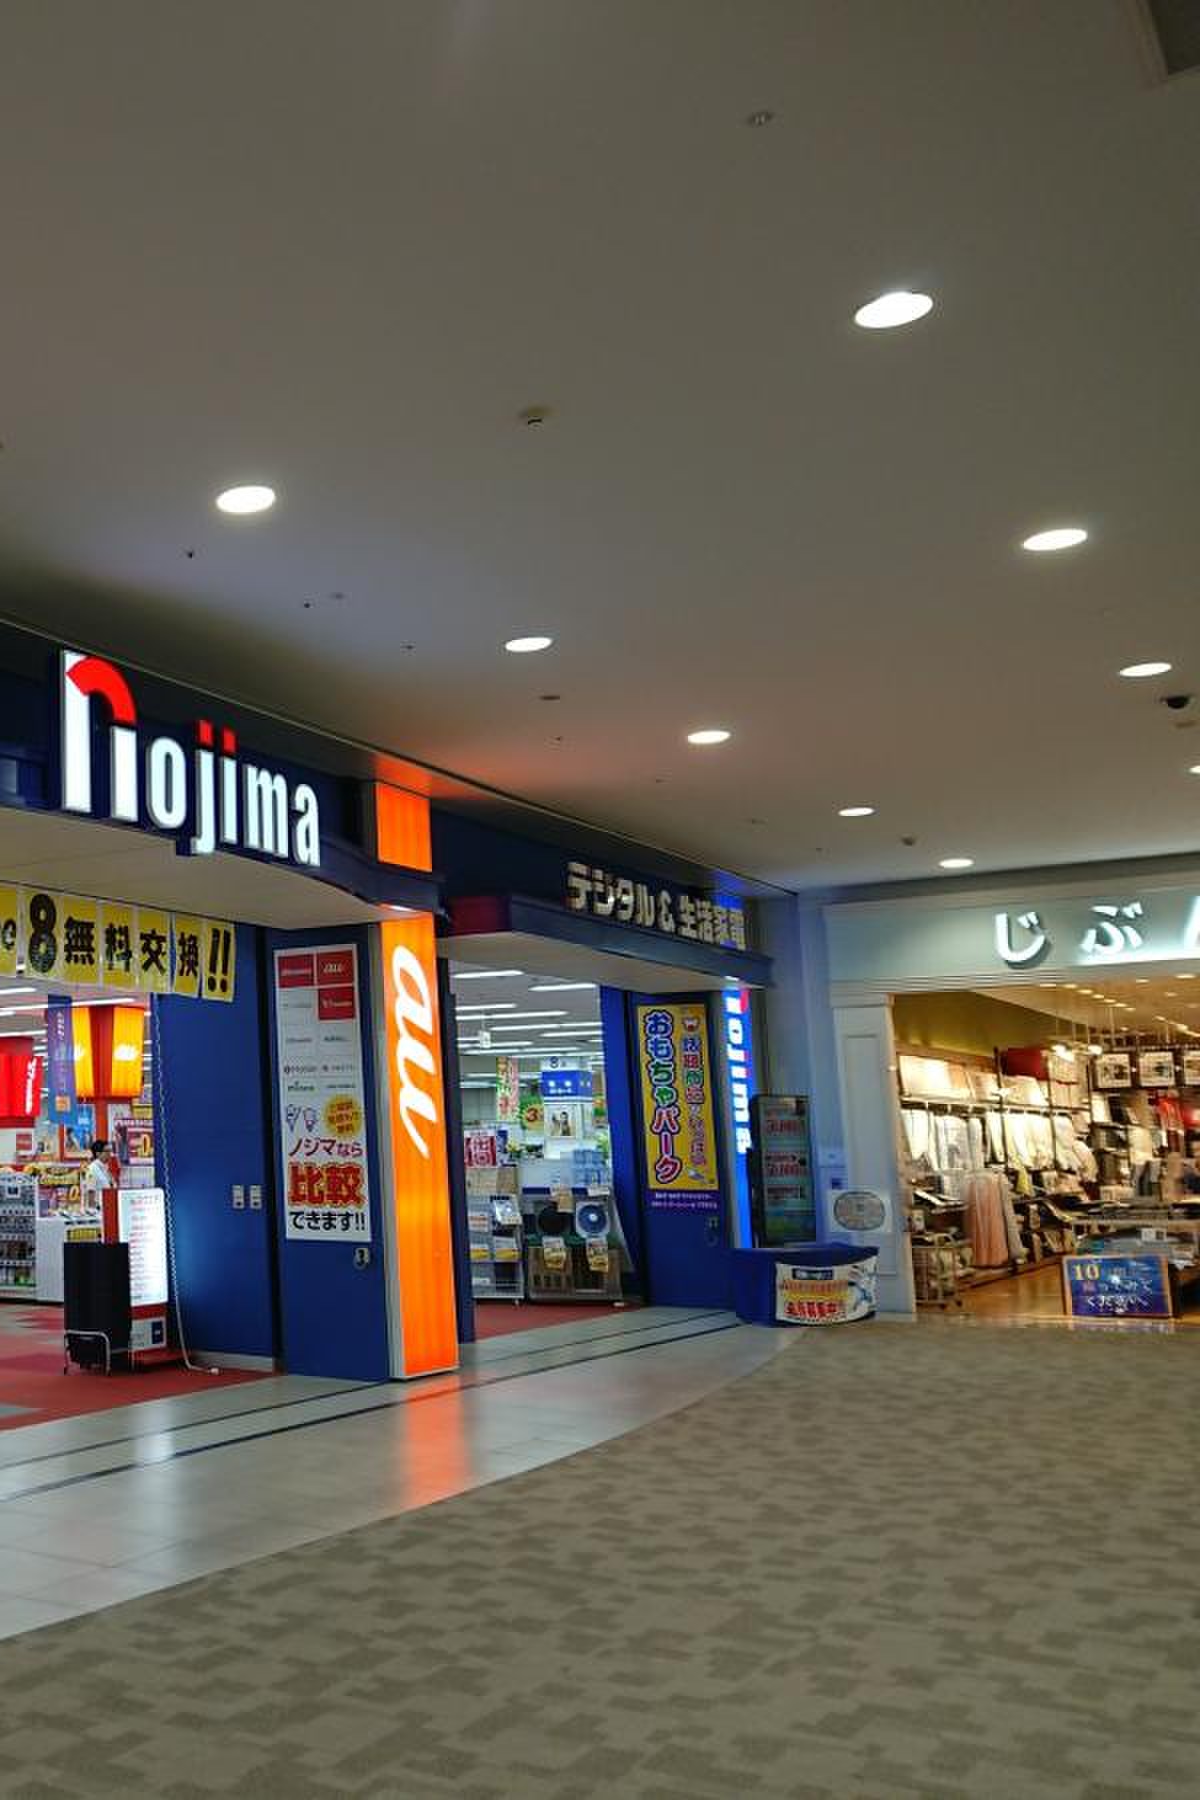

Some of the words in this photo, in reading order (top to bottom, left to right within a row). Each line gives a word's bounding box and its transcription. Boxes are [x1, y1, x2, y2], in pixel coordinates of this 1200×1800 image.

[60, 650, 321, 867] nojima
[392, 944, 439, 1160] au
[645, 1009, 683, 1184] おもちゃパーク
[287, 1161, 366, 1208] 比較
[288, 1137, 364, 1158] ノジマなら
